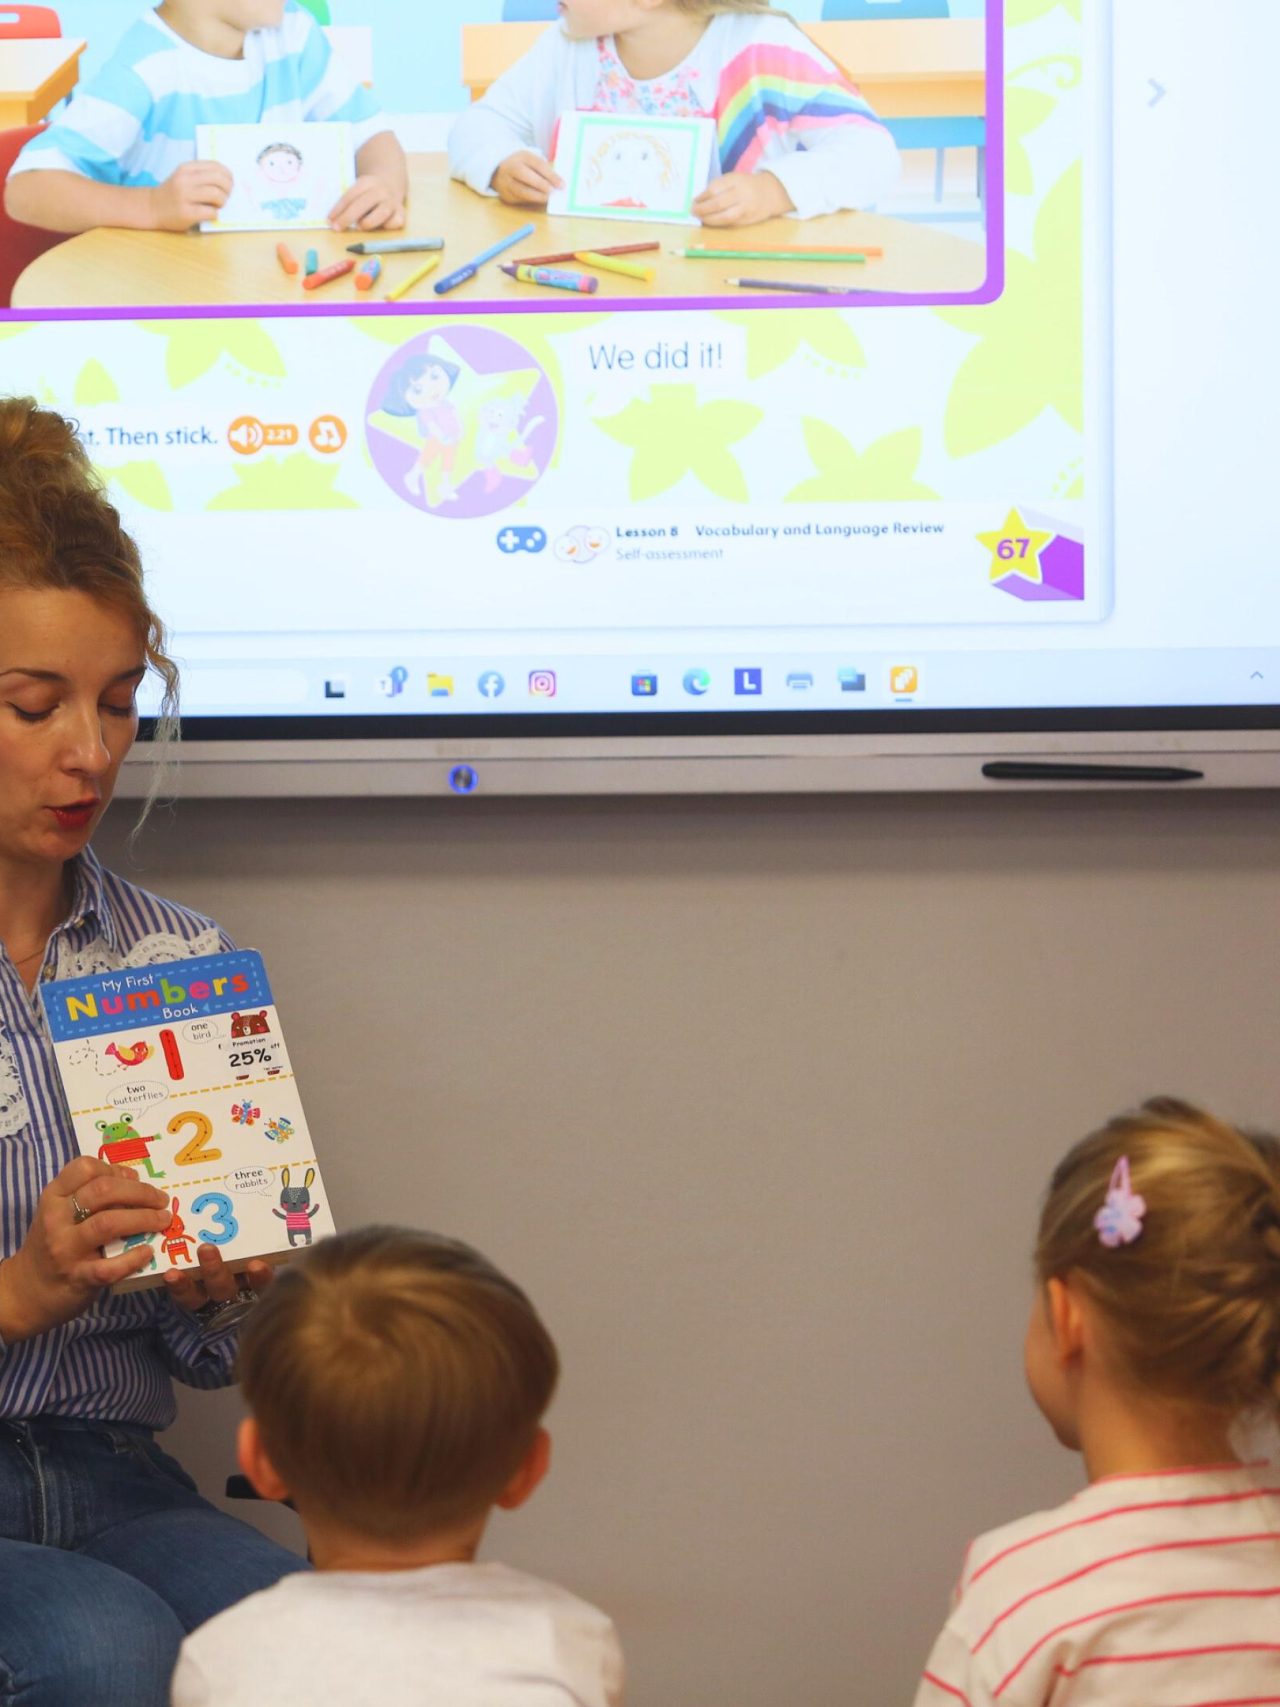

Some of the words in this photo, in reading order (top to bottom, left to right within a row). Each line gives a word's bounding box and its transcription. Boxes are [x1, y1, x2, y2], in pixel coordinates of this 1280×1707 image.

[589, 344, 634, 370] We
[645, 341, 688, 369] did
[700, 342, 722, 369] it!
[105, 427, 158, 445] Then
[165, 426, 218, 445] stick.
[616, 526, 666, 537] Lesson
[695, 524, 779, 538] Vocabulary
[784, 524, 811, 535] and
[815, 523, 888, 536] Language
[893, 522, 945, 534] Review
[616, 547, 723, 561] Self-assessment
[996, 538, 1030, 560] 67
[101, 979, 122, 992] My
[125, 973, 154, 988] First
[65, 973, 250, 1021] Numbers
[162, 1003, 199, 1019] Book
[191, 1022, 208, 1031] one
[192, 1031, 212, 1040] bird
[232, 1038, 267, 1047] Promotion
[159, 1029, 185, 1080] 1
[228, 1048, 272, 1067] 25%
[126, 1085, 146, 1094] two
[113, 1092, 164, 1106] butterflies
[166, 1111, 222, 1166] 2
[234, 1170, 264, 1180] three
[234, 1179, 269, 1190] rabbits
[191, 1192, 239, 1245] 3
